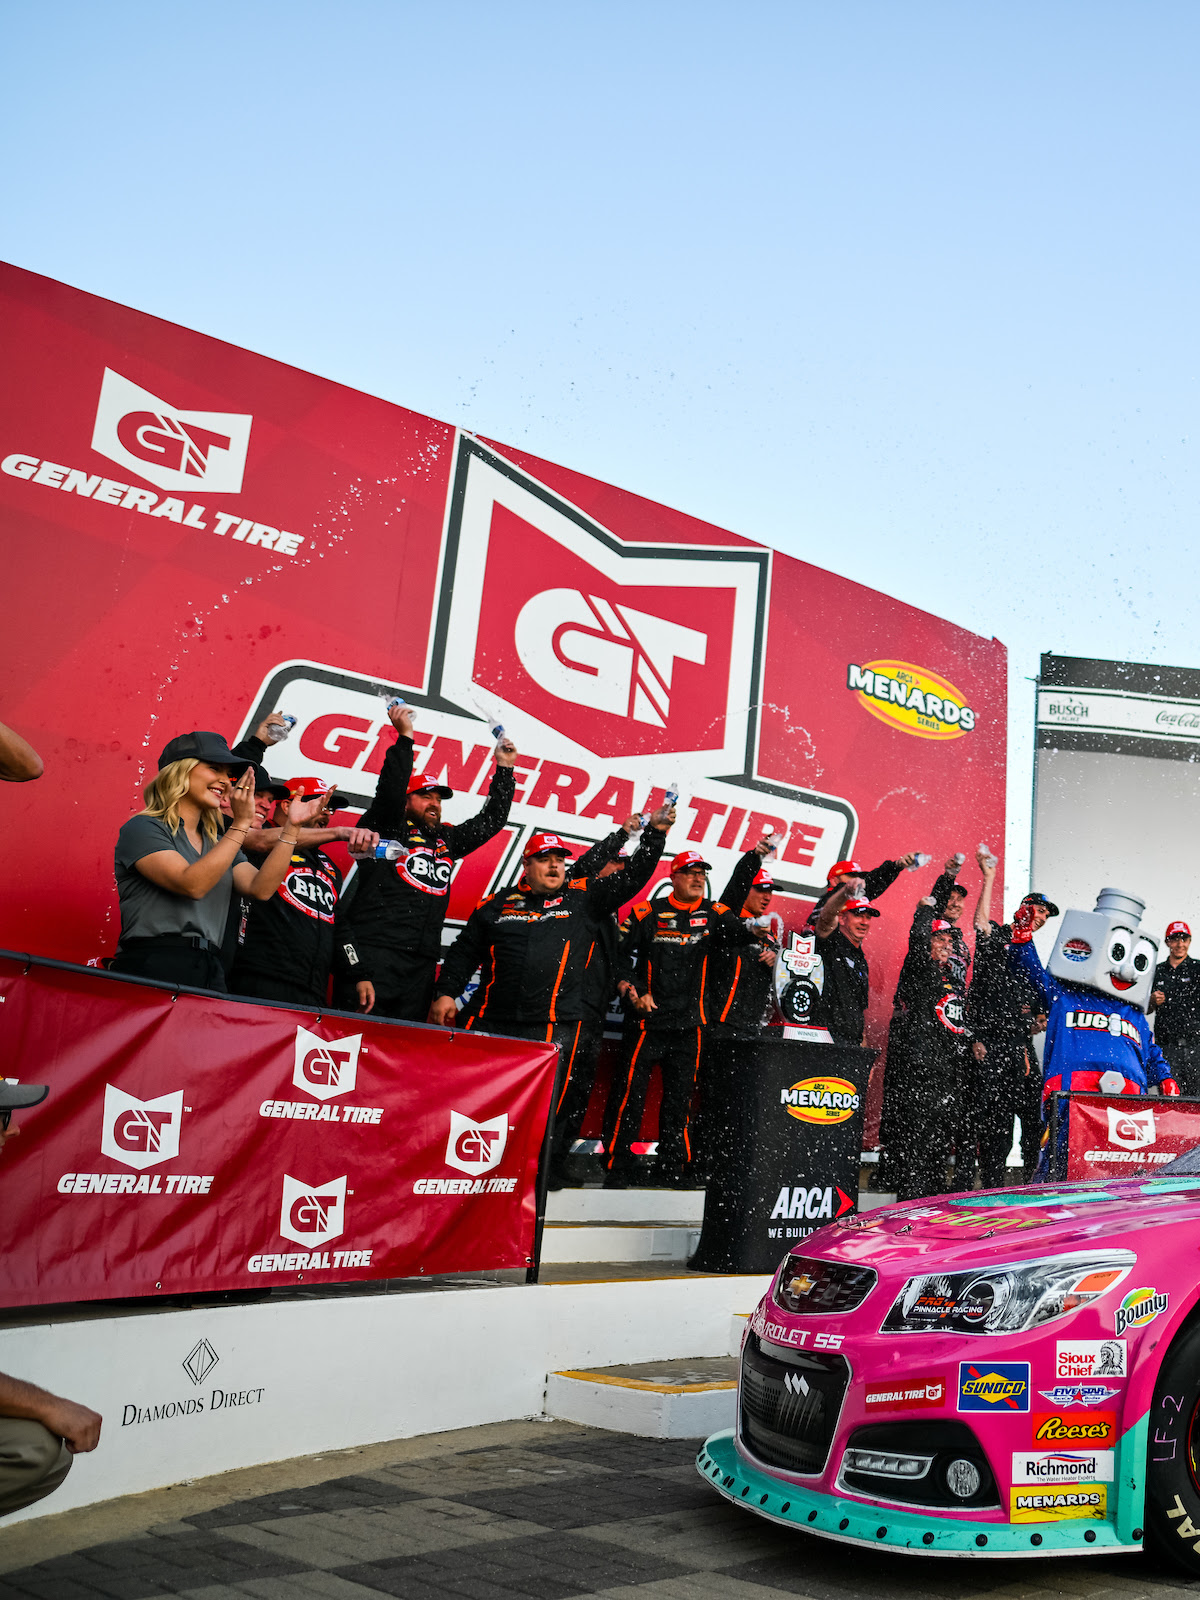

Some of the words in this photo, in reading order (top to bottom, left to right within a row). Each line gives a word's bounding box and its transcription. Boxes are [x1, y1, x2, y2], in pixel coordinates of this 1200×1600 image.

[1, 453, 207, 529] GENERAL
[213, 512, 304, 557] TIRE
[515, 588, 708, 728] GT
[896, 670, 914, 684] ARCA
[846, 664, 976, 731] MENARDS
[1049, 704, 1089, 718] BUSCH
[917, 716, 940, 731] SERIES
[686, 796, 824, 868] TIRE
[293, 875, 334, 911] BRC
[793, 960, 809, 968] 150
[302, 1049, 351, 1086] GT
[780, 1089, 860, 1110] MENARDS
[259, 1100, 339, 1122] GENERAL
[340, 1106, 384, 1124] TIRE
[113, 1108, 172, 1152] GT
[1116, 1119, 1149, 1141] GT
[454, 1130, 501, 1163] GT
[1084, 1150, 1145, 1163] GENERAL
[1144, 1152, 1177, 1163] TIRE
[57, 1173, 162, 1194] GENERAL
[162, 1175, 214, 1194] TIRE
[413, 1178, 482, 1195] GENERAL
[482, 1178, 518, 1193] TIRE
[770, 1186, 832, 1219] ARCA
[289, 1195, 337, 1232] GT
[768, 1227, 783, 1239] WE
[786, 1227, 814, 1239] BUILD
[247, 1252, 330, 1273] GENERAL
[330, 1249, 373, 1268] TIRE
[1115, 1293, 1168, 1336] Bounty
[813, 1333, 845, 1349] SS
[1058, 1352, 1096, 1364] Sioux
[1058, 1364, 1092, 1377] Chief
[865, 1391, 904, 1404] GENERAL
[904, 1389, 925, 1399] TIRE
[964, 1382, 1023, 1394] SUNOCO
[1054, 1387, 1079, 1395] FIVE
[1081, 1387, 1105, 1395] STAR
[121, 1397, 204, 1428] DIAMONDS
[209, 1388, 265, 1410] DIRECT
[1036, 1417, 1111, 1440] Reese's
[1153, 1394, 1184, 1461] LF-2
[1026, 1457, 1096, 1476] Richmond
[1016, 1493, 1101, 1509] MENARDS
